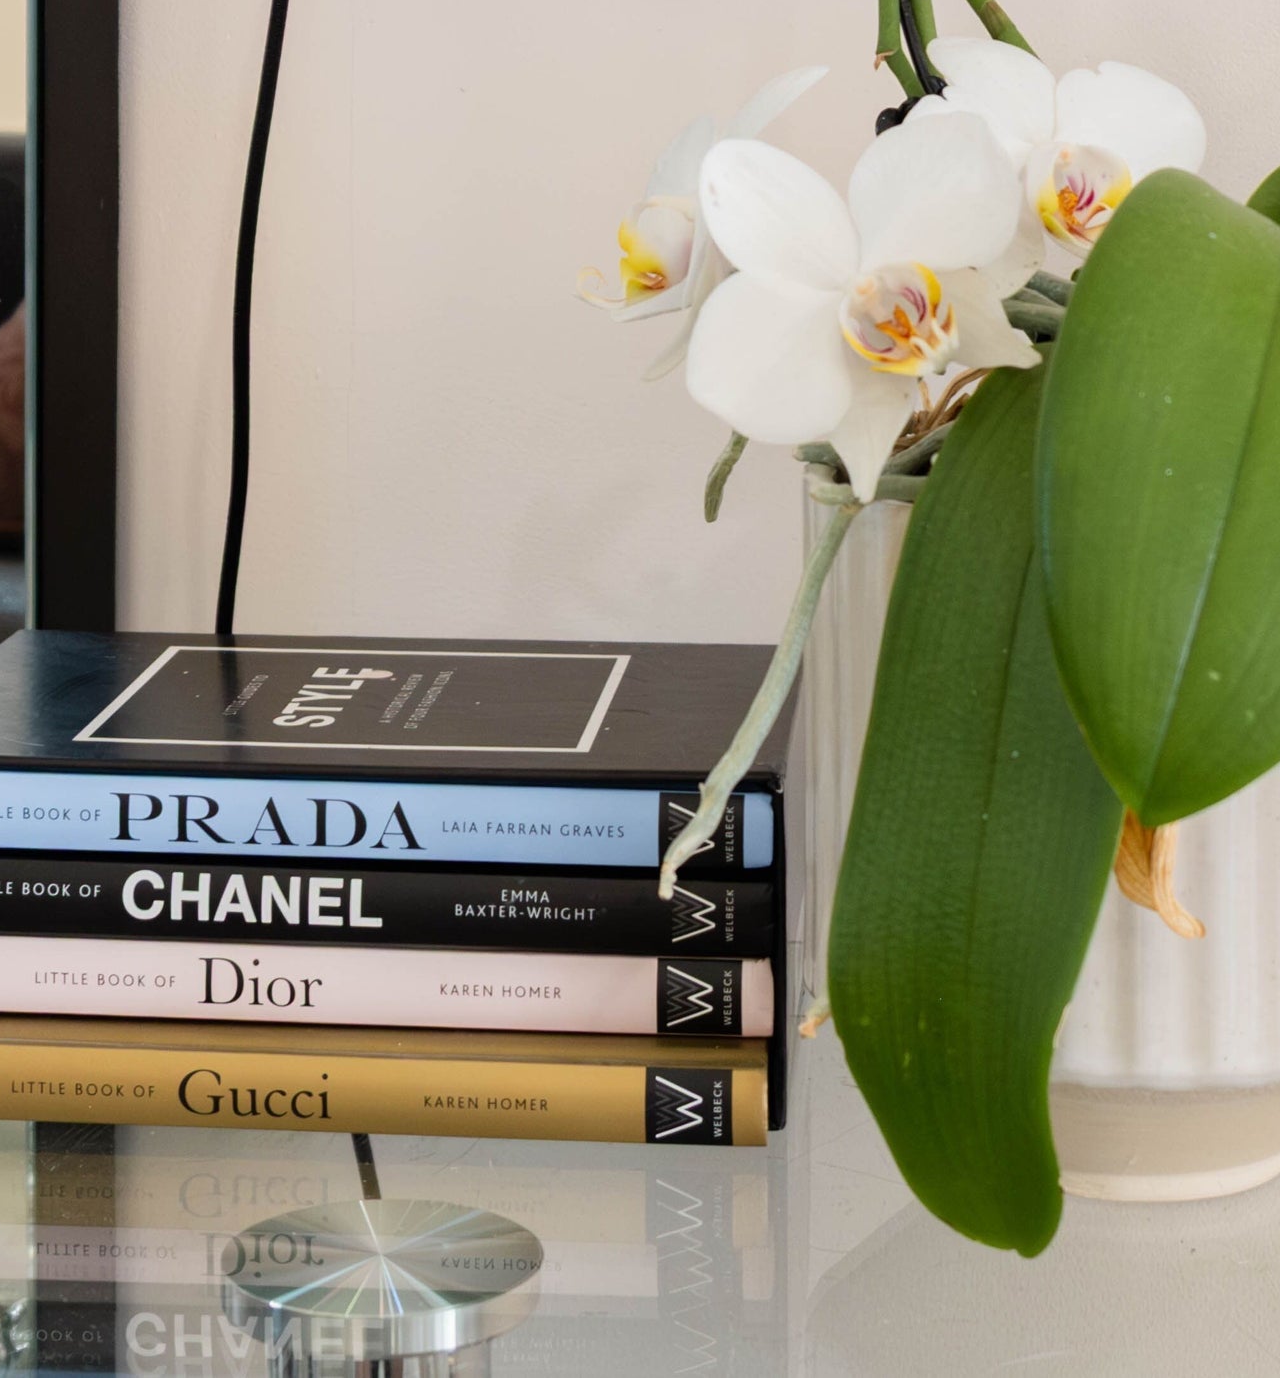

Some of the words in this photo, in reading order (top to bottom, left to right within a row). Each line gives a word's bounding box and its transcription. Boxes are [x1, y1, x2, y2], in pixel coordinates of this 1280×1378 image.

[272, 667, 378, 728] STYLE
[22, 806, 71, 821] BOOK
[80, 809, 102, 822] OF
[110, 792, 428, 850] PRADA
[442, 821, 478, 834] LAIA
[486, 822, 552, 837] FARRAN
[560, 824, 625, 838] GRAVES
[725, 805, 736, 863] WELBECK
[21, 882, 71, 897] BOOK
[79, 884, 102, 898] OF
[122, 869, 383, 928] CHANEL
[454, 904, 596, 921] BAXTER-WRIGHT
[501, 889, 550, 903] EMMA
[725, 889, 735, 942] WELBECK
[35, 971, 88, 986] LITTLE
[97, 973, 146, 988] BOOK
[154, 975, 176, 988] OF
[198, 957, 323, 1008] Dior
[440, 983, 493, 997] KAREN
[502, 985, 562, 999] HOMER
[723, 970, 733, 1026] WELBECK
[11, 1080, 65, 1095] LITTLE
[75, 1082, 125, 1097] BOOK
[133, 1085, 155, 1098] OF
[178, 1069, 332, 1120] Gucci
[423, 1095, 480, 1109] KAREN
[487, 1097, 549, 1112] HOMER
[713, 1080, 724, 1138] WELBECK
